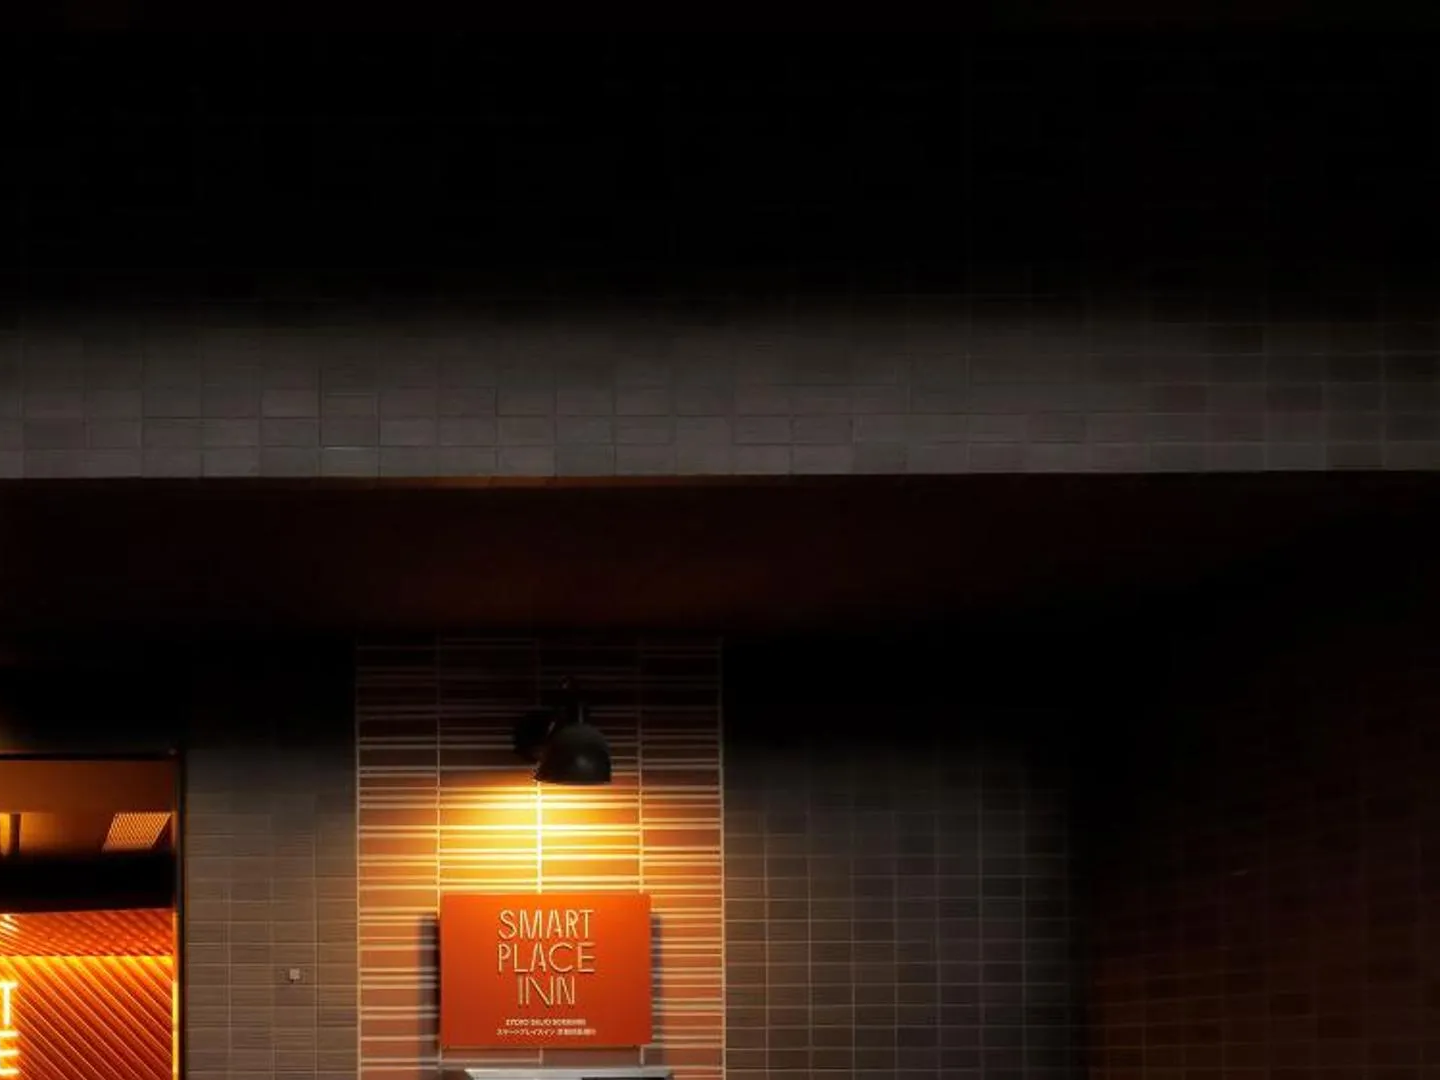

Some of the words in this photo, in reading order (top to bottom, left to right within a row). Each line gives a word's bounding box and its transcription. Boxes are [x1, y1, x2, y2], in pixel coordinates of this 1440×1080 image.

[498, 909, 594, 939] SMART
[498, 943, 596, 973] PLACE
[518, 975, 576, 1005] INN
